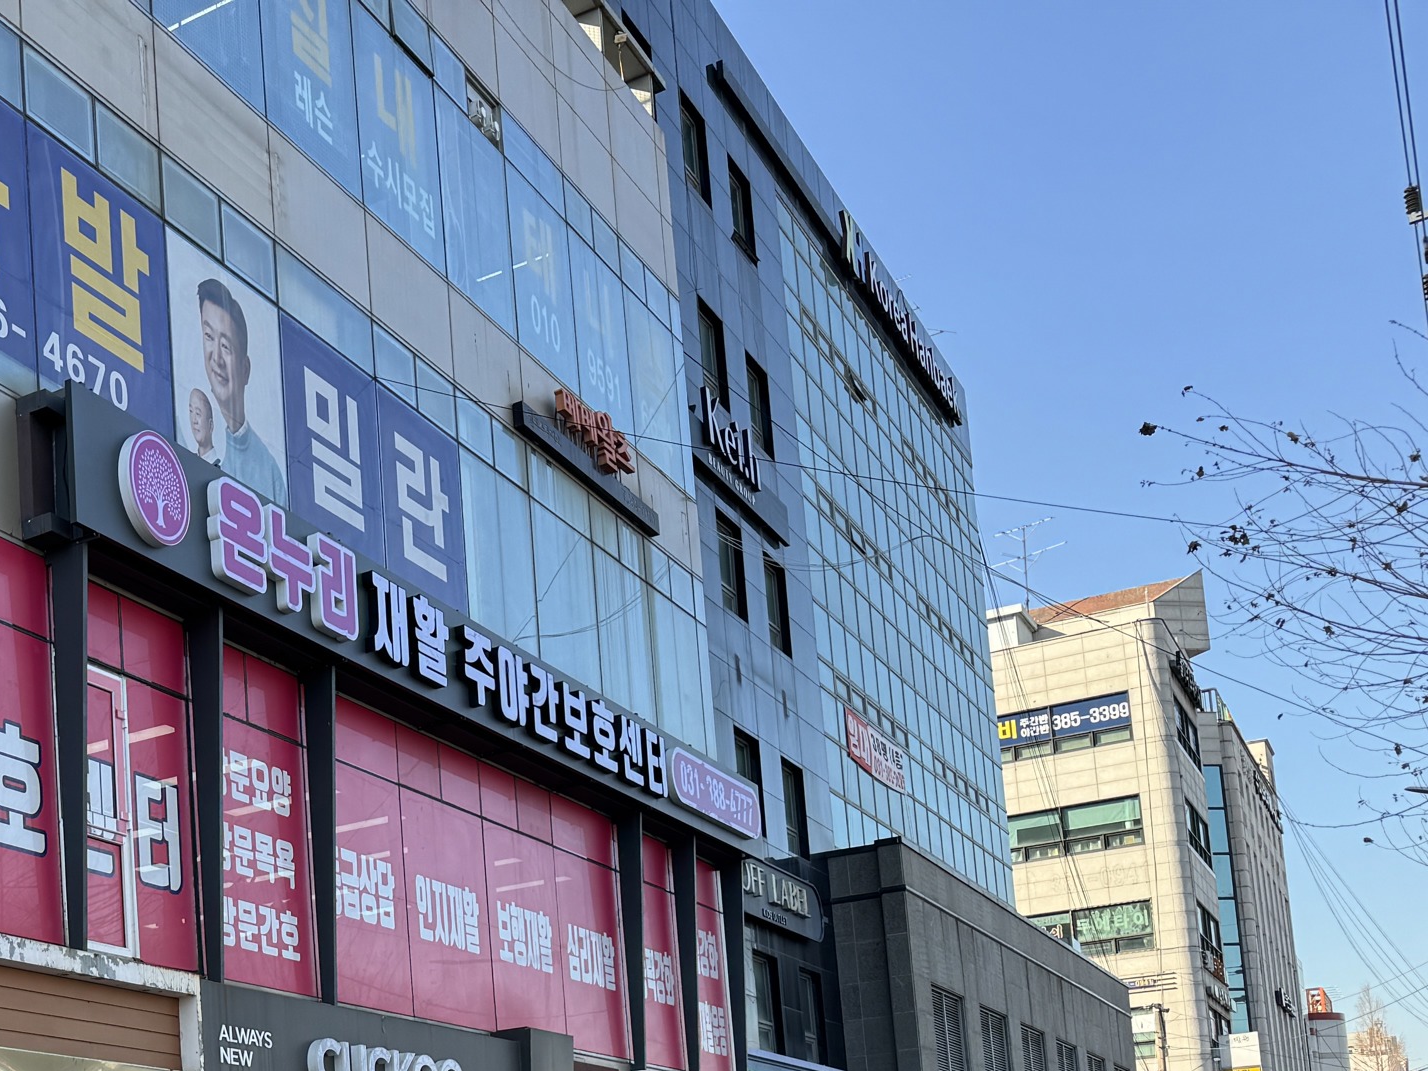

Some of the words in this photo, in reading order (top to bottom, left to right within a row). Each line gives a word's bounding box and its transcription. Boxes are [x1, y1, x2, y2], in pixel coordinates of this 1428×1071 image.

[294, 71, 333, 145] 레슨
[367, 141, 436, 239] 수시모집
[530, 294, 561, 353] 010
[586, 347, 621, 409] 9591
[305, 366, 450, 583] 밀란
[209, 478, 358, 640] 온누리
[373, 571, 449, 687] 재활
[463, 624, 667, 799] 주야간보호센터
[1020, 714, 1048, 727] 주간반
[1052, 702, 1129, 730] 385-3399
[335, 845, 395, 930] 급상담
[415, 874, 481, 955] 인지재활
[769, 873, 812, 918] LABEL
[497, 900, 554, 975] 보행재활
[567, 923, 617, 992] 심리재활
[696, 928, 720, 981] 강화
[644, 947, 675, 1007] 력강화
[219, 1024, 273, 1049] ALWAYS
[220, 1046, 253, 1068] NEW
